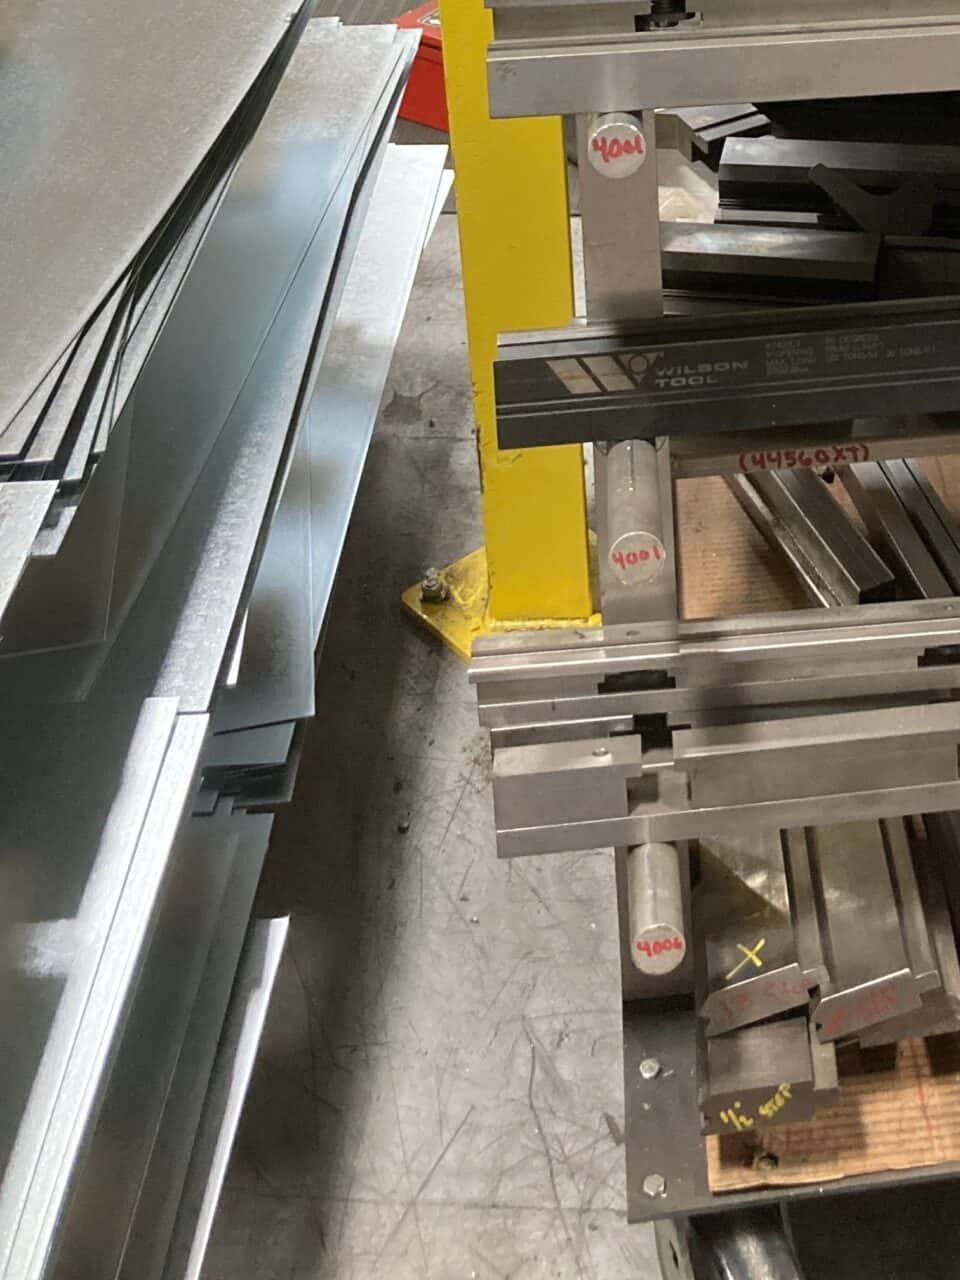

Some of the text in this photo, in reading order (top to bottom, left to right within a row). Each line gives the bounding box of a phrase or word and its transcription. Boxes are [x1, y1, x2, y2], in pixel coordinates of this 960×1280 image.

[655, 360, 750, 377] WILSON
[655, 375, 719, 389] TOOL
[611, 544, 661, 570] 4001
